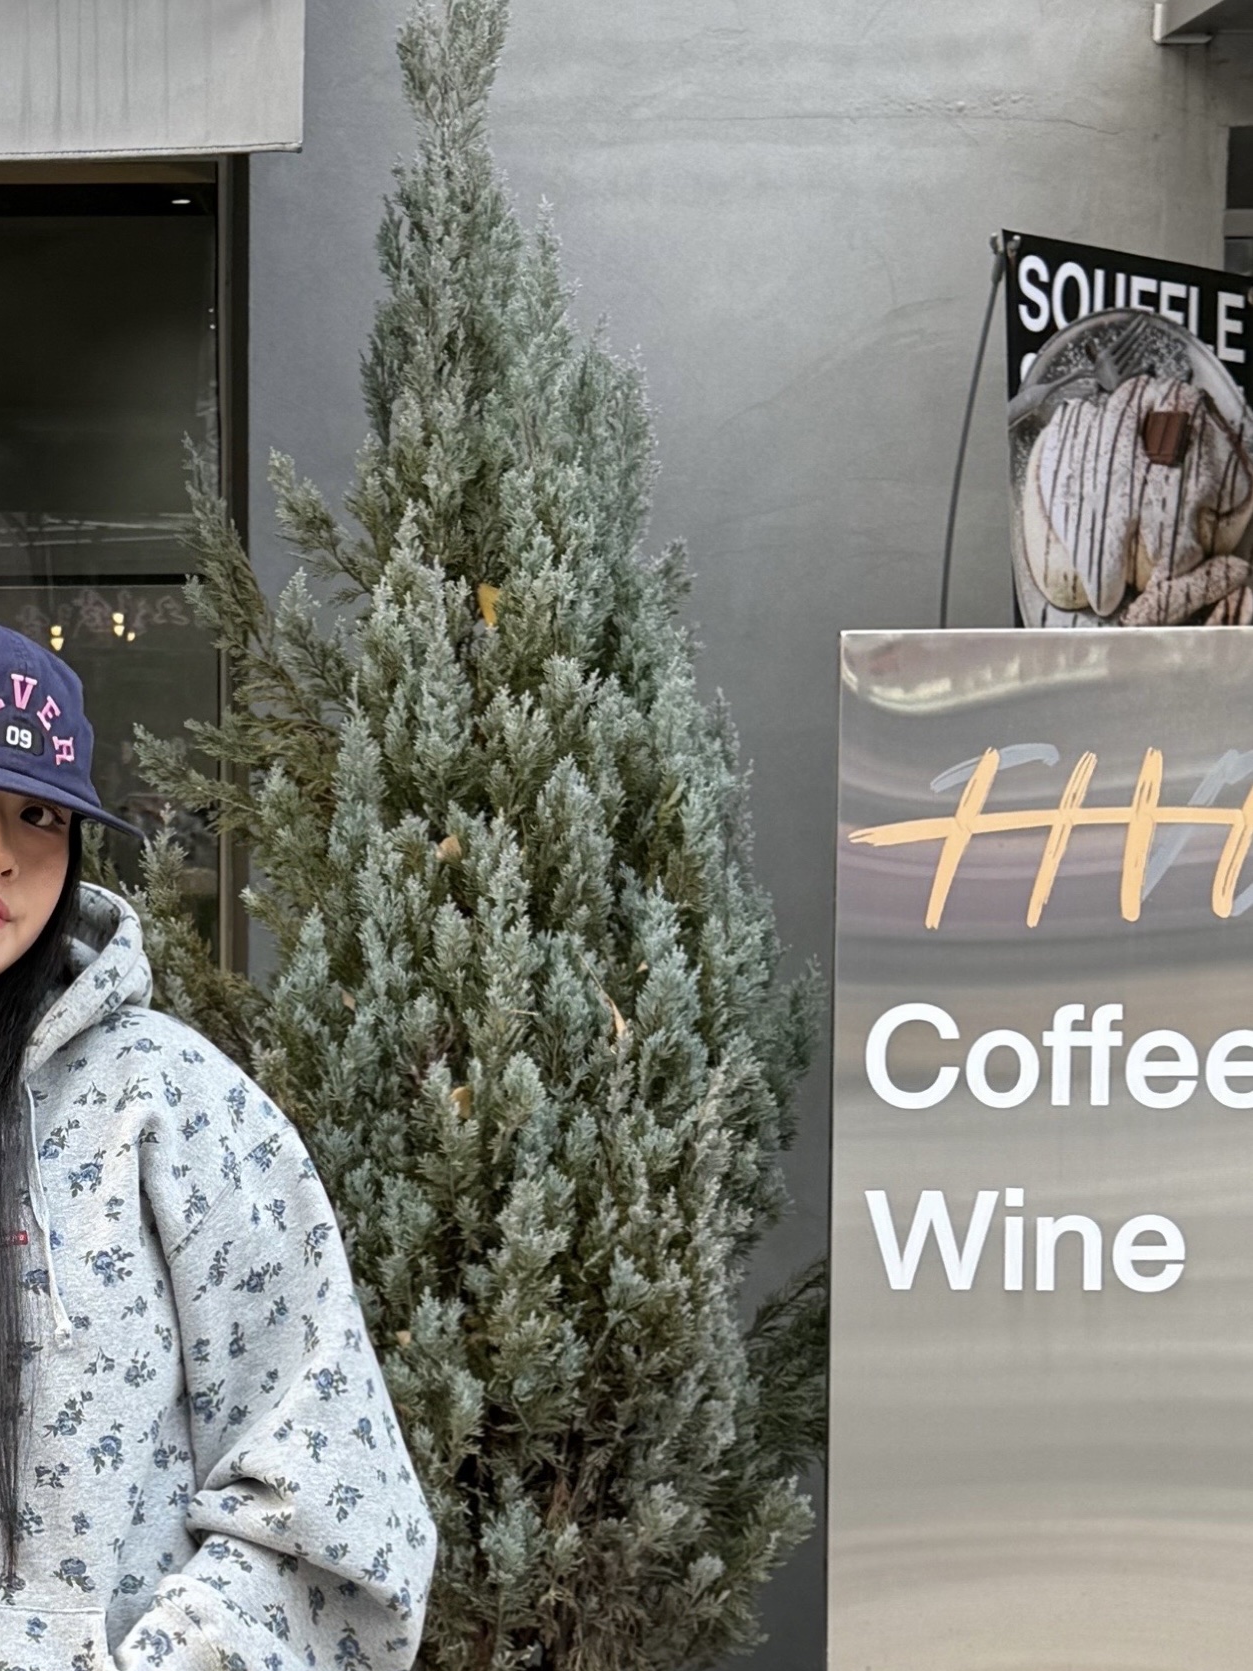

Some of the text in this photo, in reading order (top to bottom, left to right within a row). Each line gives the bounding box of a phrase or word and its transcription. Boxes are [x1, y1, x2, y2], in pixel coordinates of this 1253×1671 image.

[6, 725, 33, 749] 09
[865, 1002, 1253, 1109] Coffee
[864, 1187, 1186, 1293] Wine
